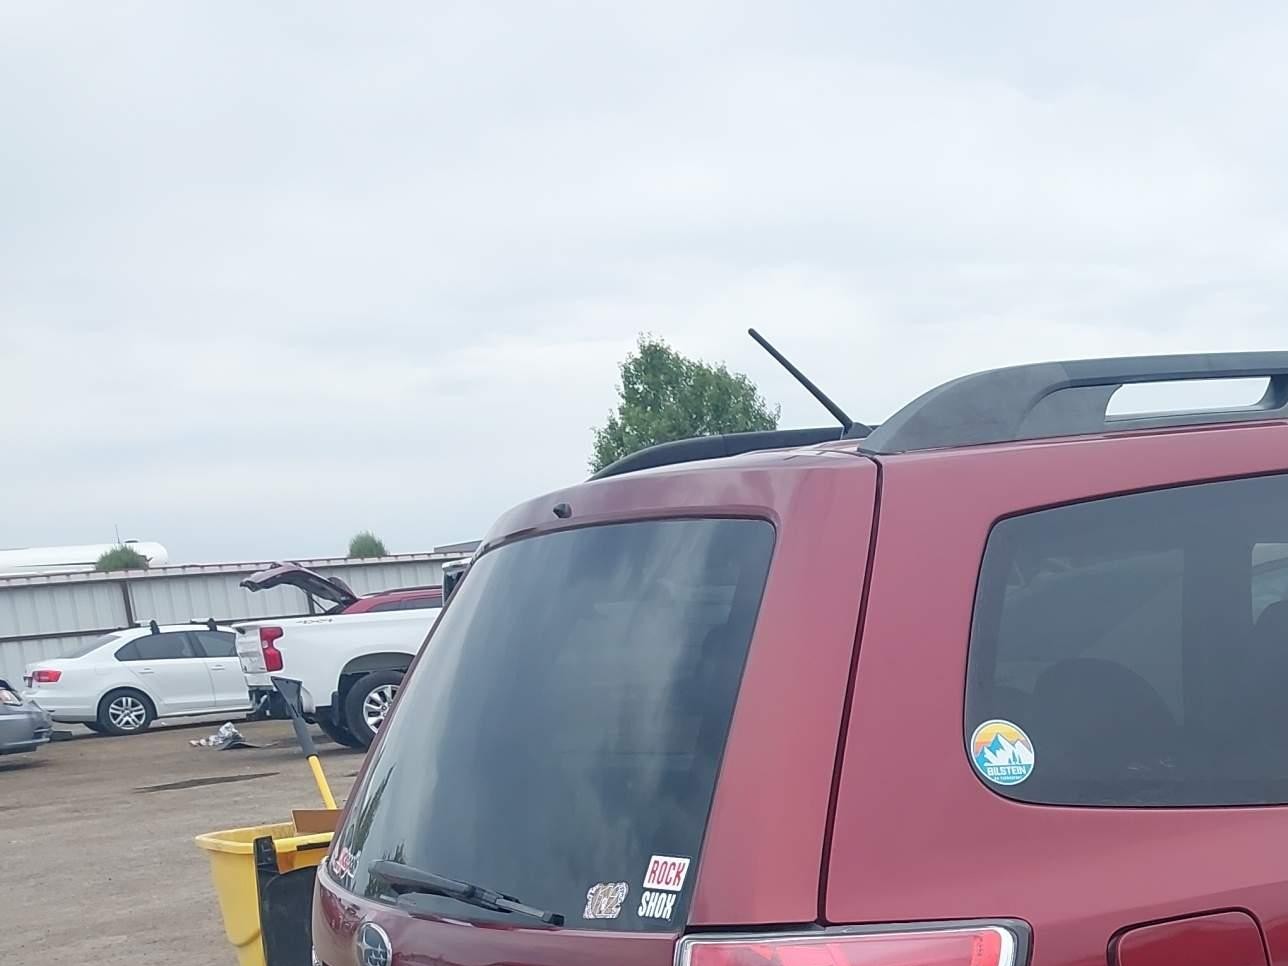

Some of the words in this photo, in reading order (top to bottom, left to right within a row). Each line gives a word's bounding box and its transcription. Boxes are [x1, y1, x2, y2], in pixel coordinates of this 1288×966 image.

[987, 765, 1027, 776] BILSTEIN
[647, 860, 687, 887] ROCK
[638, 890, 677, 919] SHOX
